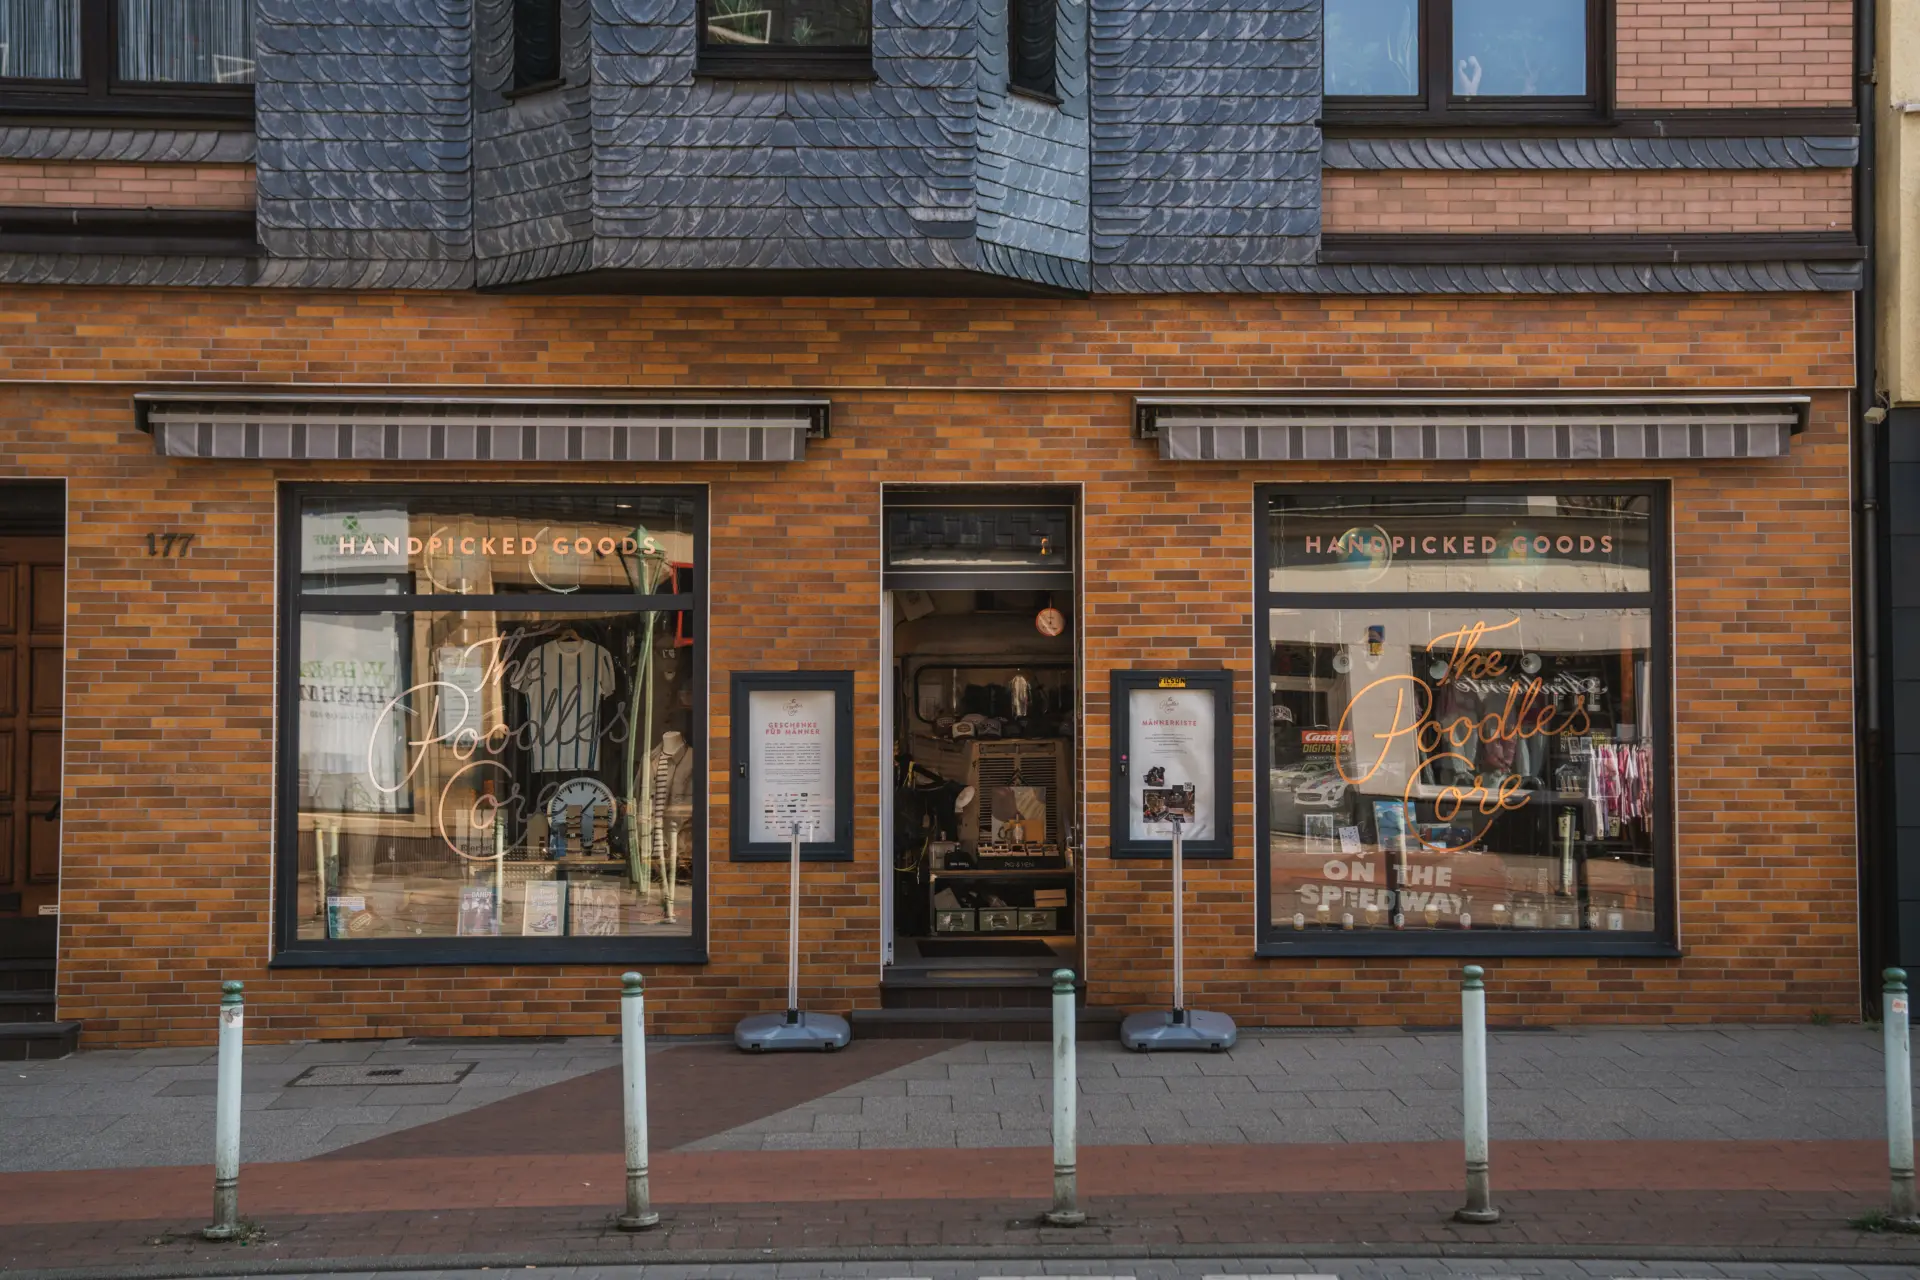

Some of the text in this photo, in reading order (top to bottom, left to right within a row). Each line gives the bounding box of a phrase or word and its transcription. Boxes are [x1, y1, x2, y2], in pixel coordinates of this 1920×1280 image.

[146, 532, 195, 557] 177
[338, 535, 538, 556] HANDPICKED
[552, 535, 658, 556] GOODS
[1305, 534, 1614, 555] HANDPICKED GOODS
[464, 623, 561, 693] The
[1426, 616, 1520, 687] The
[368, 681, 630, 793] Poodles
[1142, 718, 1197, 727] MÄNNERKISTE
[1305, 732, 1349, 743] Carrea
[1336, 674, 1591, 785] Poodles
[439, 760, 568, 861] Core
[1404, 752, 1531, 852] Core
[1323, 860, 1453, 888] ON THE
[1299, 884, 1474, 916] SPEEDWAY
